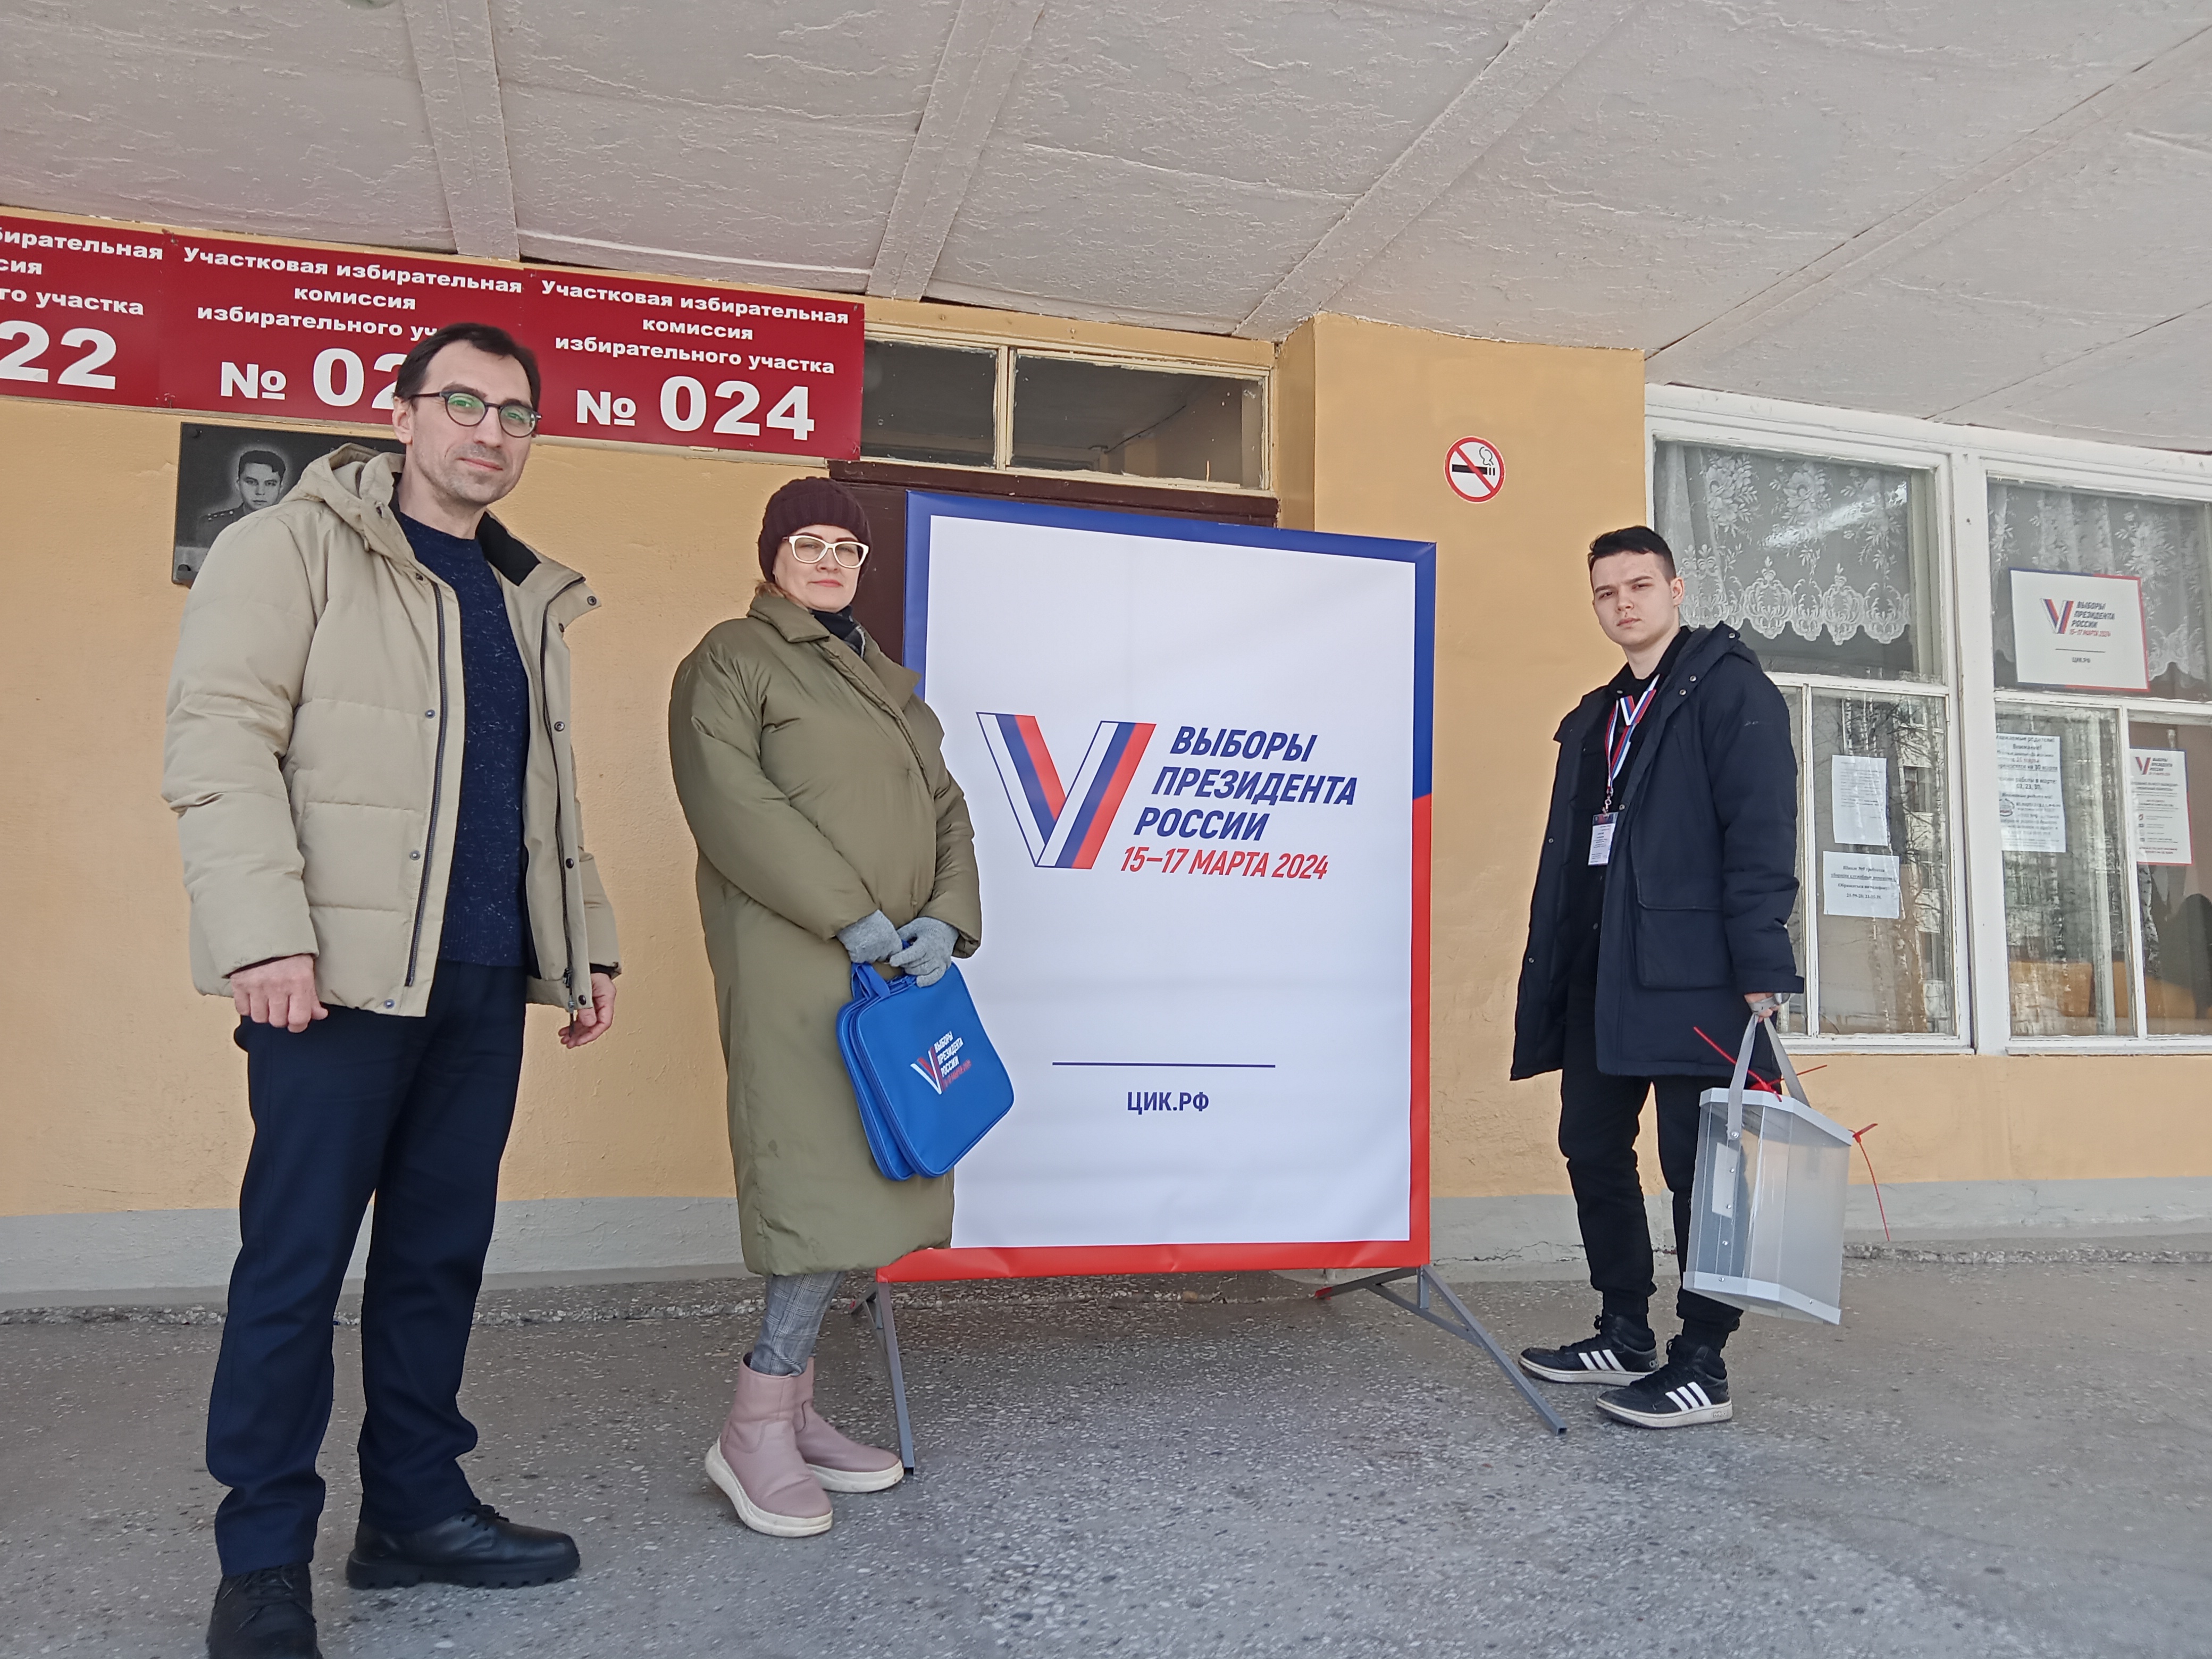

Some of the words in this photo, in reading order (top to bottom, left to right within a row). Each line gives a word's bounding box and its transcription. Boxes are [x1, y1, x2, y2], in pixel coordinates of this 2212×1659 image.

[0, 231, 163, 260] ирательная
[184, 247, 328, 275] Участковая
[337, 264, 522, 294] избирательная
[36, 291, 144, 315] участка
[294, 288, 416, 310] комиссия
[541, 280, 673, 307] Участковая
[680, 297, 848, 324] избирательная
[197, 306, 403, 336] избирательного
[643, 319, 753, 340] комиссия
[0, 320, 116, 390] 22
[555, 337, 742, 365] избирательного
[748, 355, 834, 374] участка
[220, 362, 287, 400] №
[313, 348, 408, 410] 02
[576, 389, 636, 426] №
[660, 375, 815, 441] 024
[1169, 726, 1318, 763] ВЫБОРЫ
[1151, 766, 1358, 806] ПРЕЗИДЕНТА
[1133, 807, 1270, 841] РОССИИ
[1188, 849, 1270, 877] МАРТА
[1271, 852, 1328, 879] 2024
[1127, 1091, 1210, 1116] ЦИК.РФ
